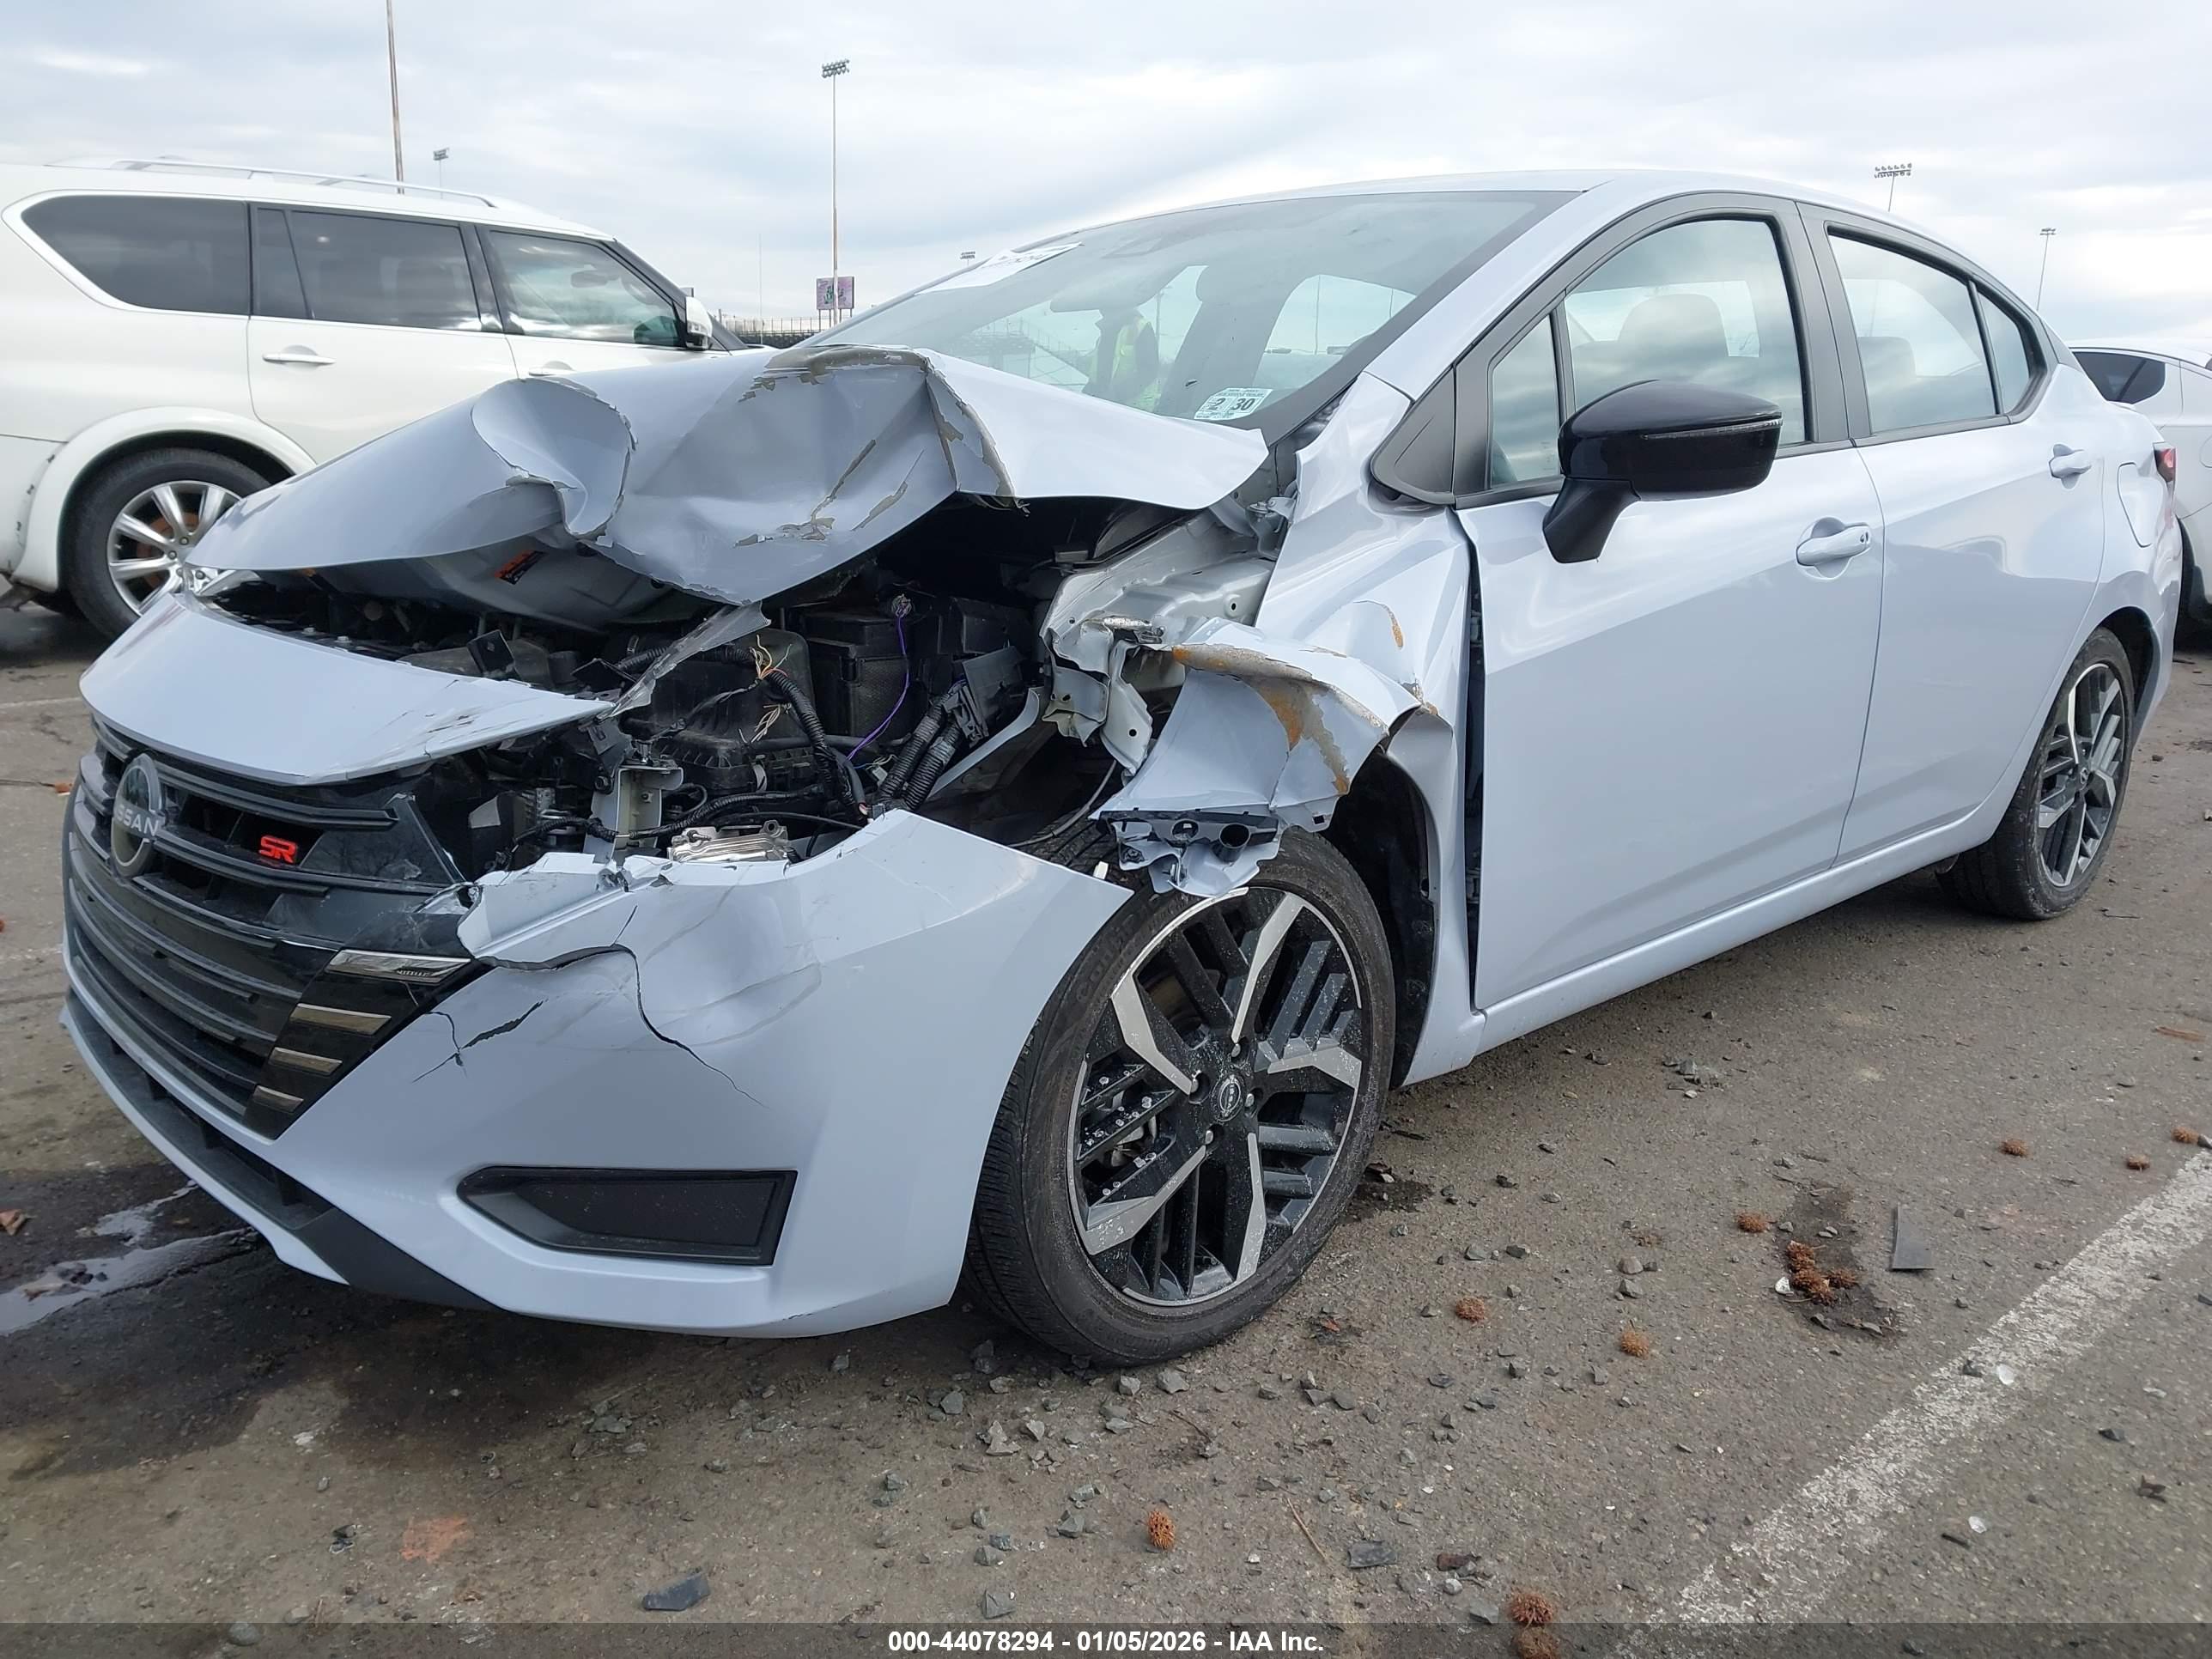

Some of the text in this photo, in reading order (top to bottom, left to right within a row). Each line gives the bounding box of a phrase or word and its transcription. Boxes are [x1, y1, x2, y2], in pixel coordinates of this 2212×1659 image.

[1229, 398, 1256, 411] 30
[116, 802, 159, 836] SSAN
[259, 836, 296, 863] SR
